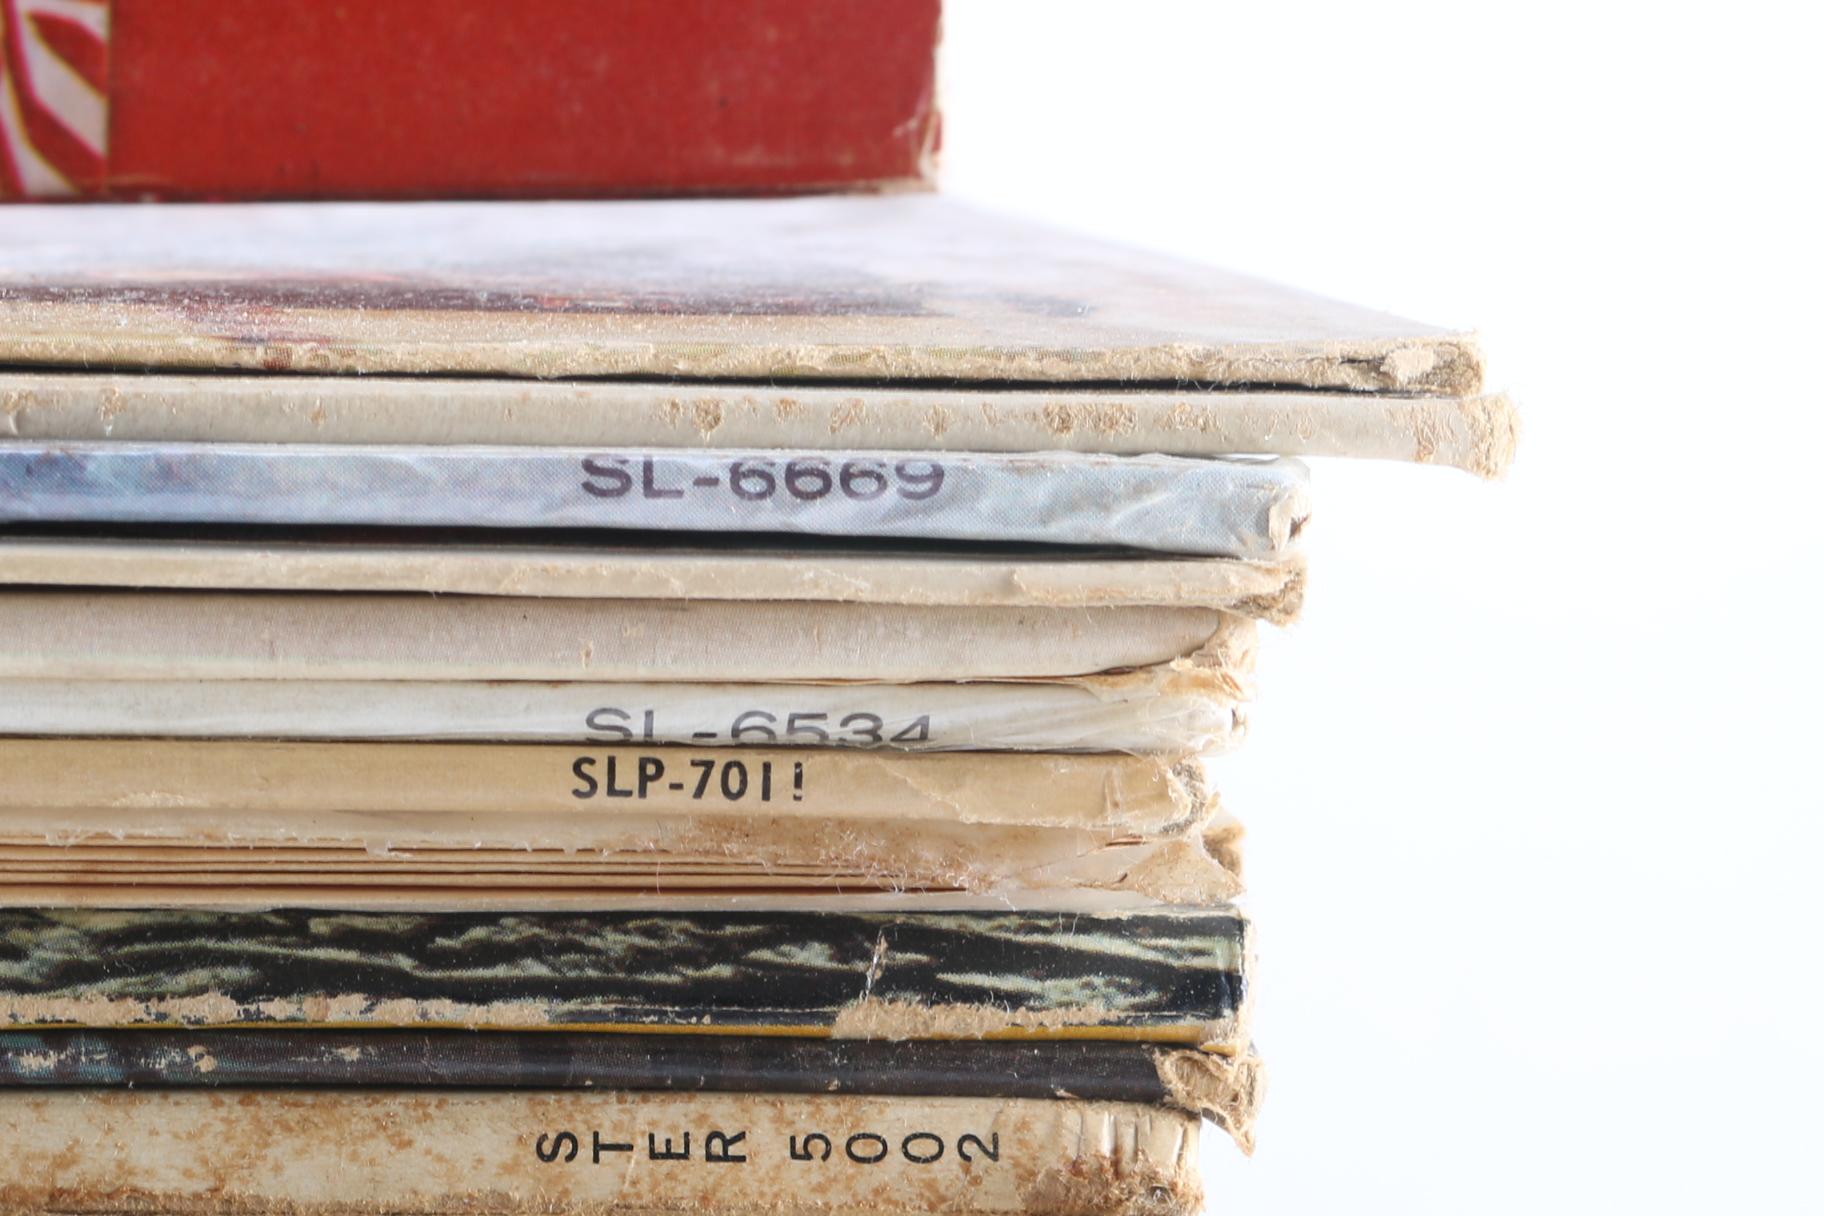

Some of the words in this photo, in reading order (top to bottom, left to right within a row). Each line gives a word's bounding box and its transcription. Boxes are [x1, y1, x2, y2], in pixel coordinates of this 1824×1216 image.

[581, 453, 945, 500] SL-6669
[535, 1130, 748, 1164] STER
[789, 1131, 1000, 1164] 5002
